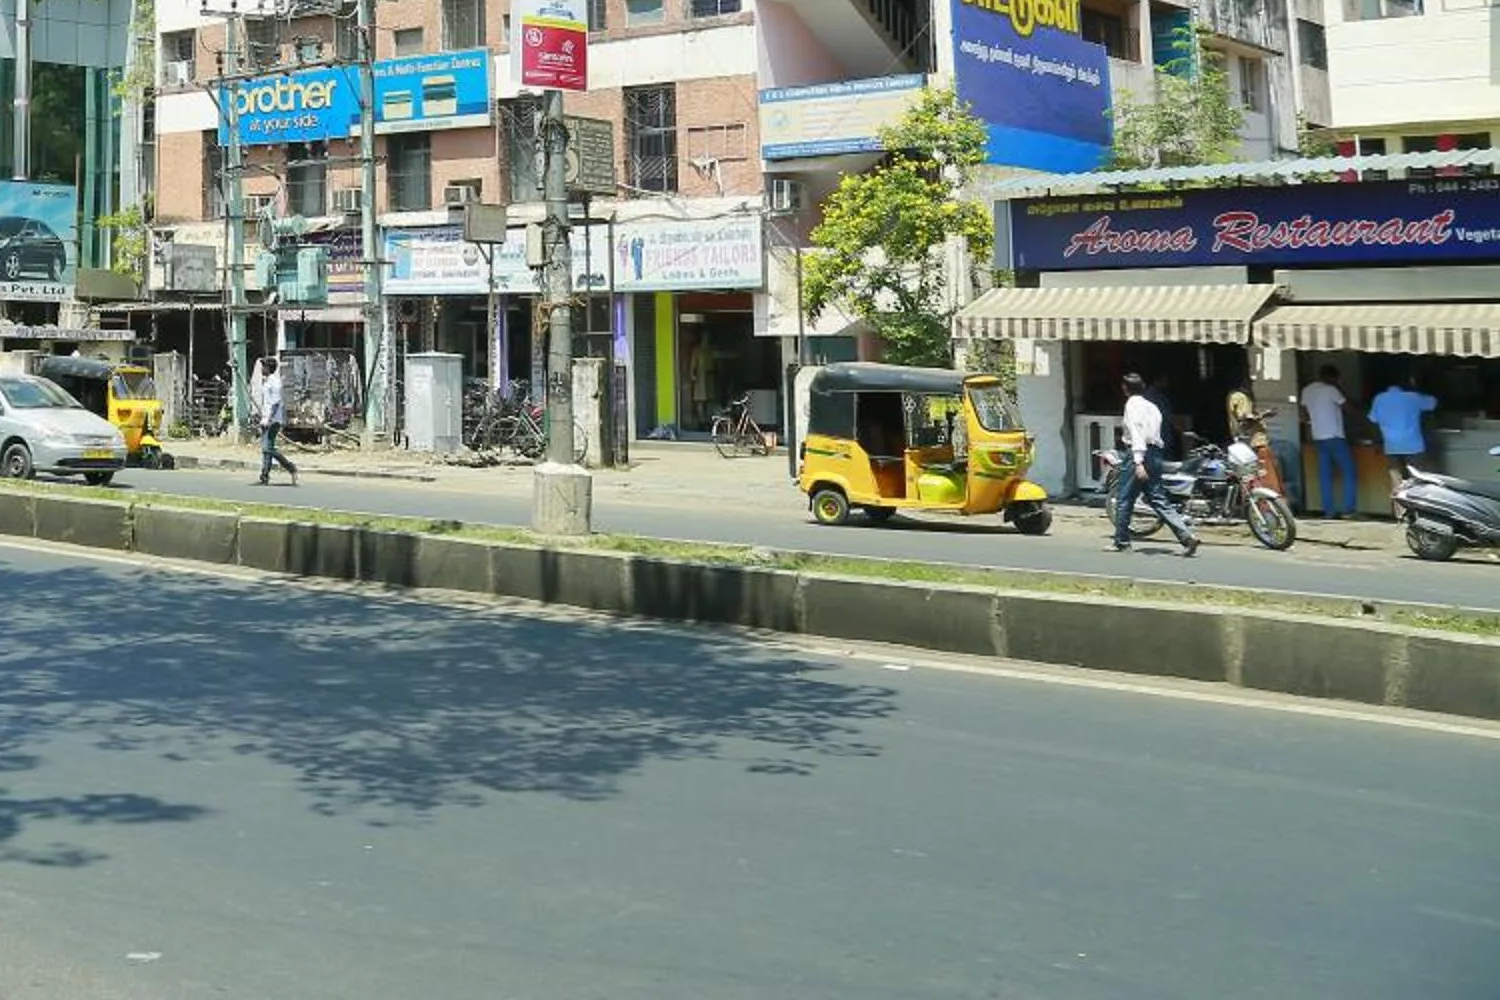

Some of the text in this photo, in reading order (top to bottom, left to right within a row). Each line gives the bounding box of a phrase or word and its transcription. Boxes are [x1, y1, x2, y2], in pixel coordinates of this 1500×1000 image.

[229, 78, 337, 115] brother
[1062, 214, 1198, 258] Aroma
[1211, 208, 1456, 253] Restaurant
